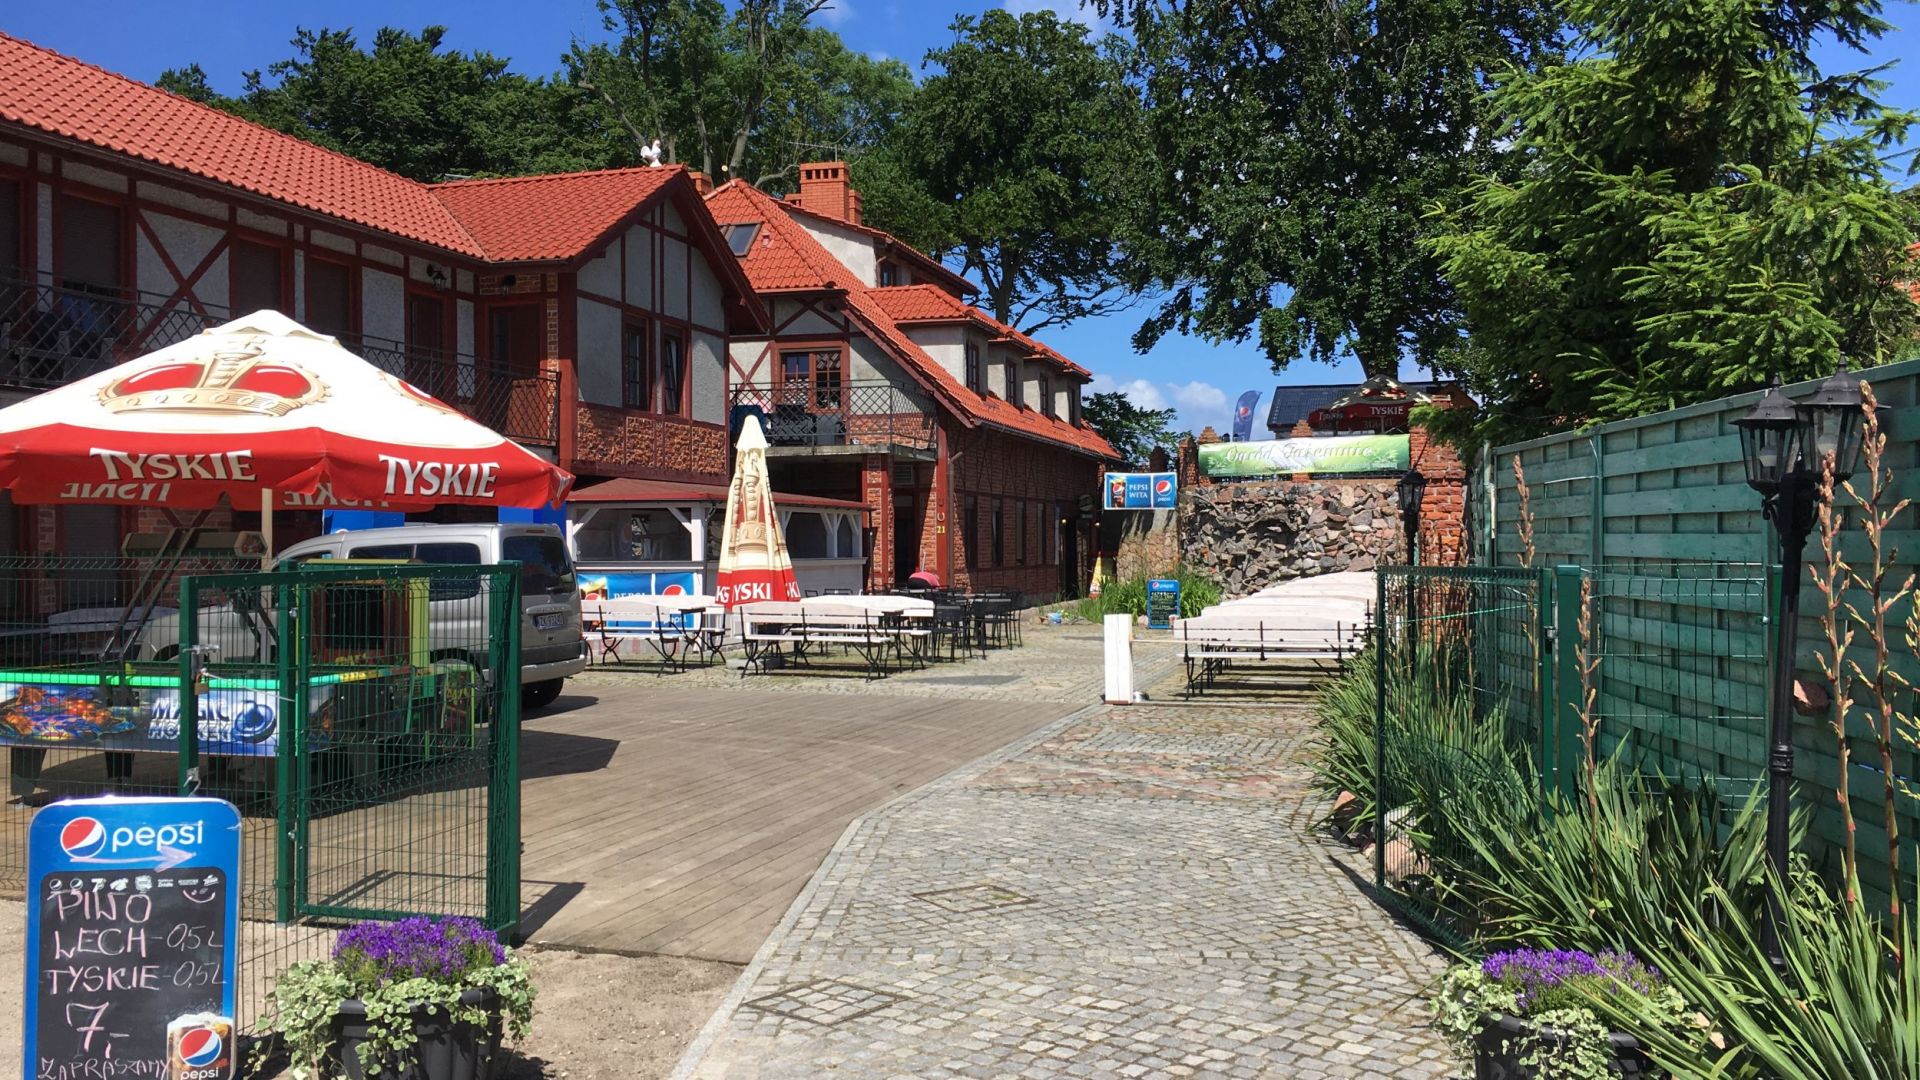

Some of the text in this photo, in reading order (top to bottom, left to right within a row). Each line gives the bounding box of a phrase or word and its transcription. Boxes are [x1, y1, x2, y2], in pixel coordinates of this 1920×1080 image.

[1369, 406, 1404, 416] TYSKIE
[89, 447, 257, 482] TYSKIE
[378, 453, 500, 499] TYSKIE
[936, 525, 946, 534] 21
[733, 582, 772, 602] YSKI
[112, 820, 204, 853] pepsi
[54, 926, 147, 959] LECH
[43, 965, 161, 995] TYSKIE
[180, 1067, 220, 1080] pepsi
